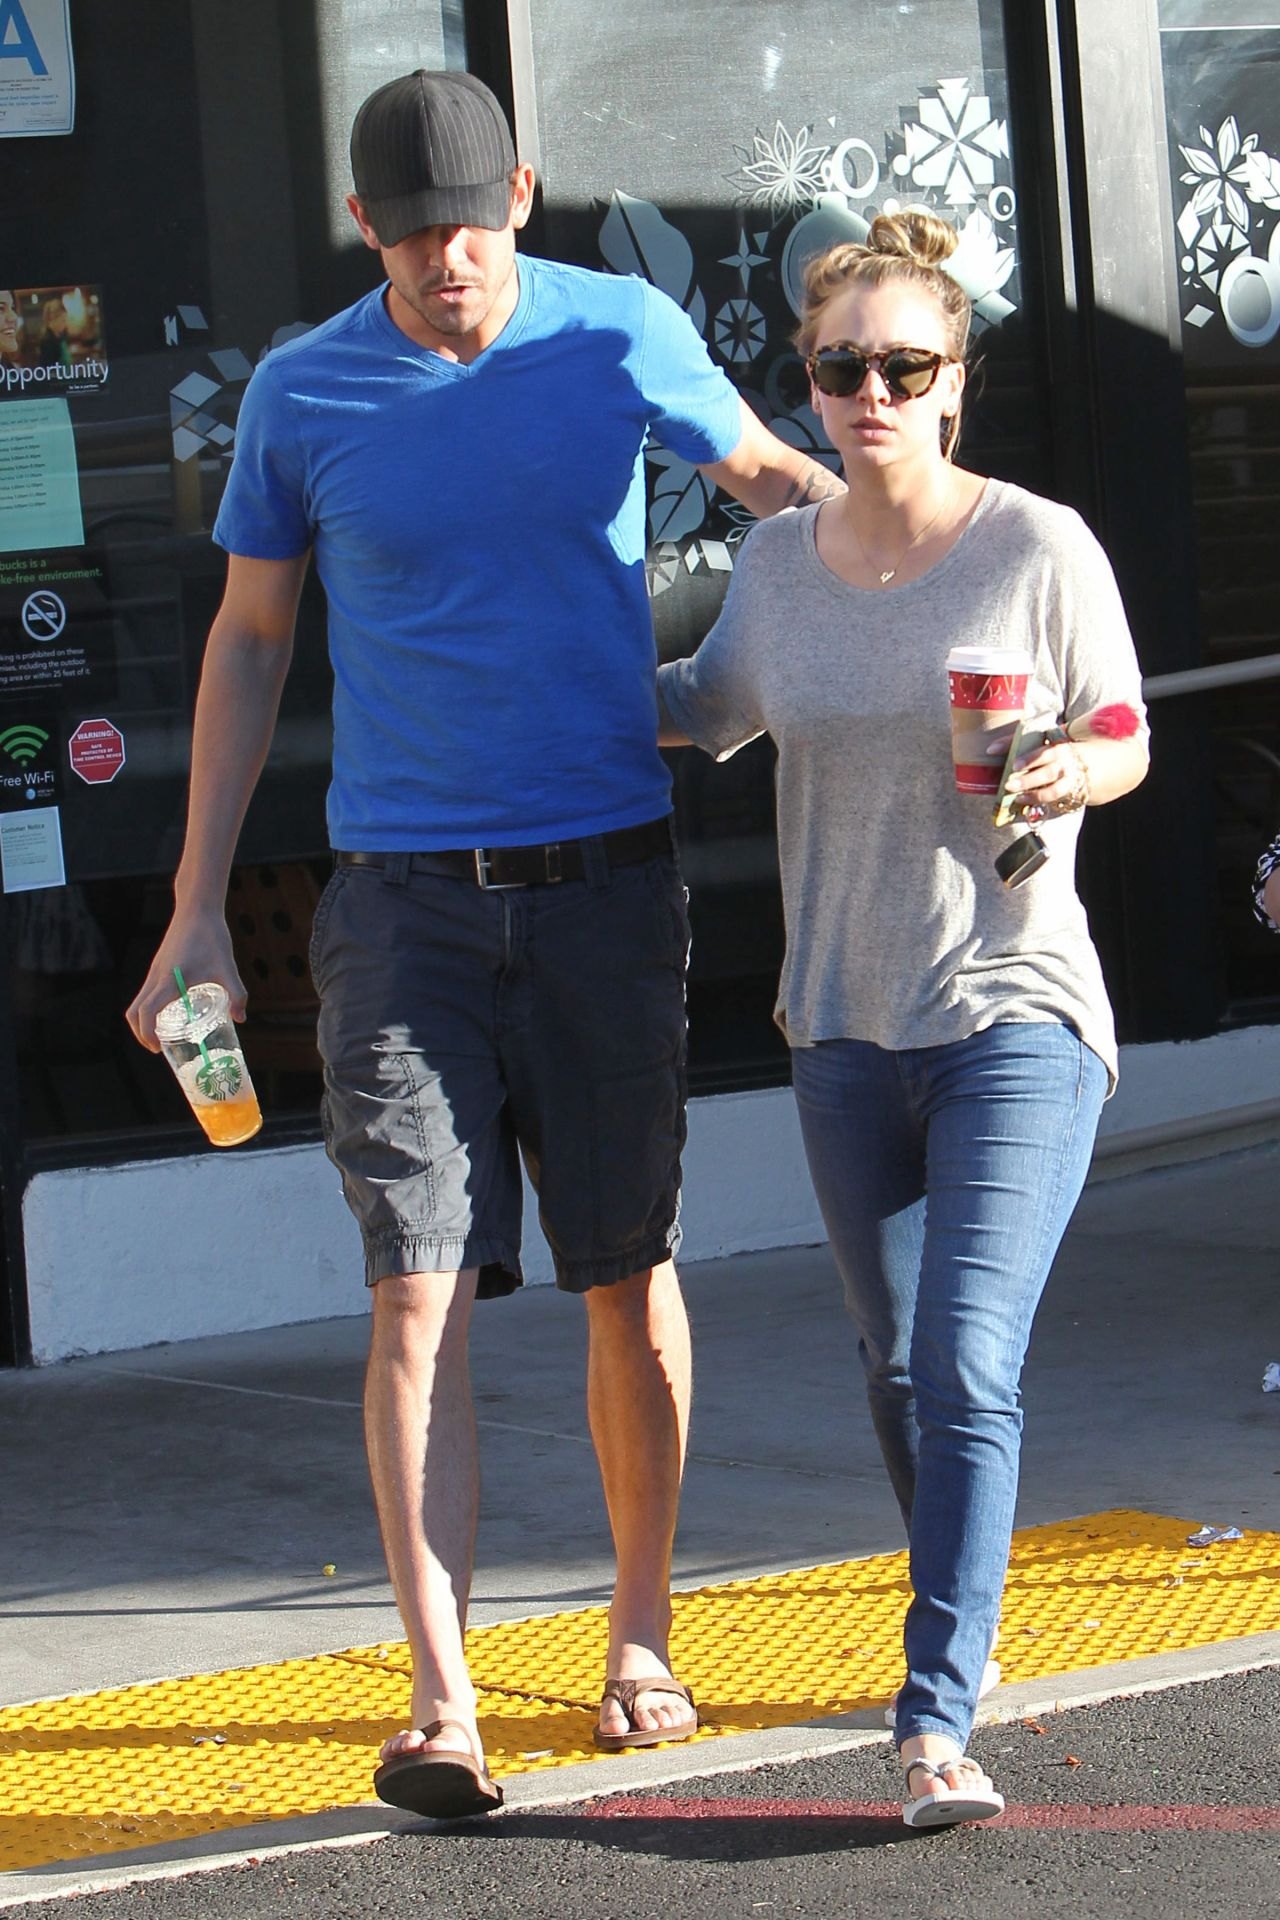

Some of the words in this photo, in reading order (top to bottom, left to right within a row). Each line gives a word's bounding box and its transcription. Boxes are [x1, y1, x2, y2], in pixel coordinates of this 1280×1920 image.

[0, 0, 49, 75] A
[30, 559, 38, 568] is
[40, 560, 47, 568] a
[39, 567, 103, 581] environment.
[22, 650, 56, 660] prohibited
[19, 662, 48, 670] including
[48, 660, 60, 668] the
[60, 658, 86, 666] outdoor
[53, 670, 62, 678] 25
[62, 669, 76, 677] feet
[77, 667, 84, 675] of
[77, 729, 114, 740] WARNING!
[24, 771, 54, 785] Wi-Fi
